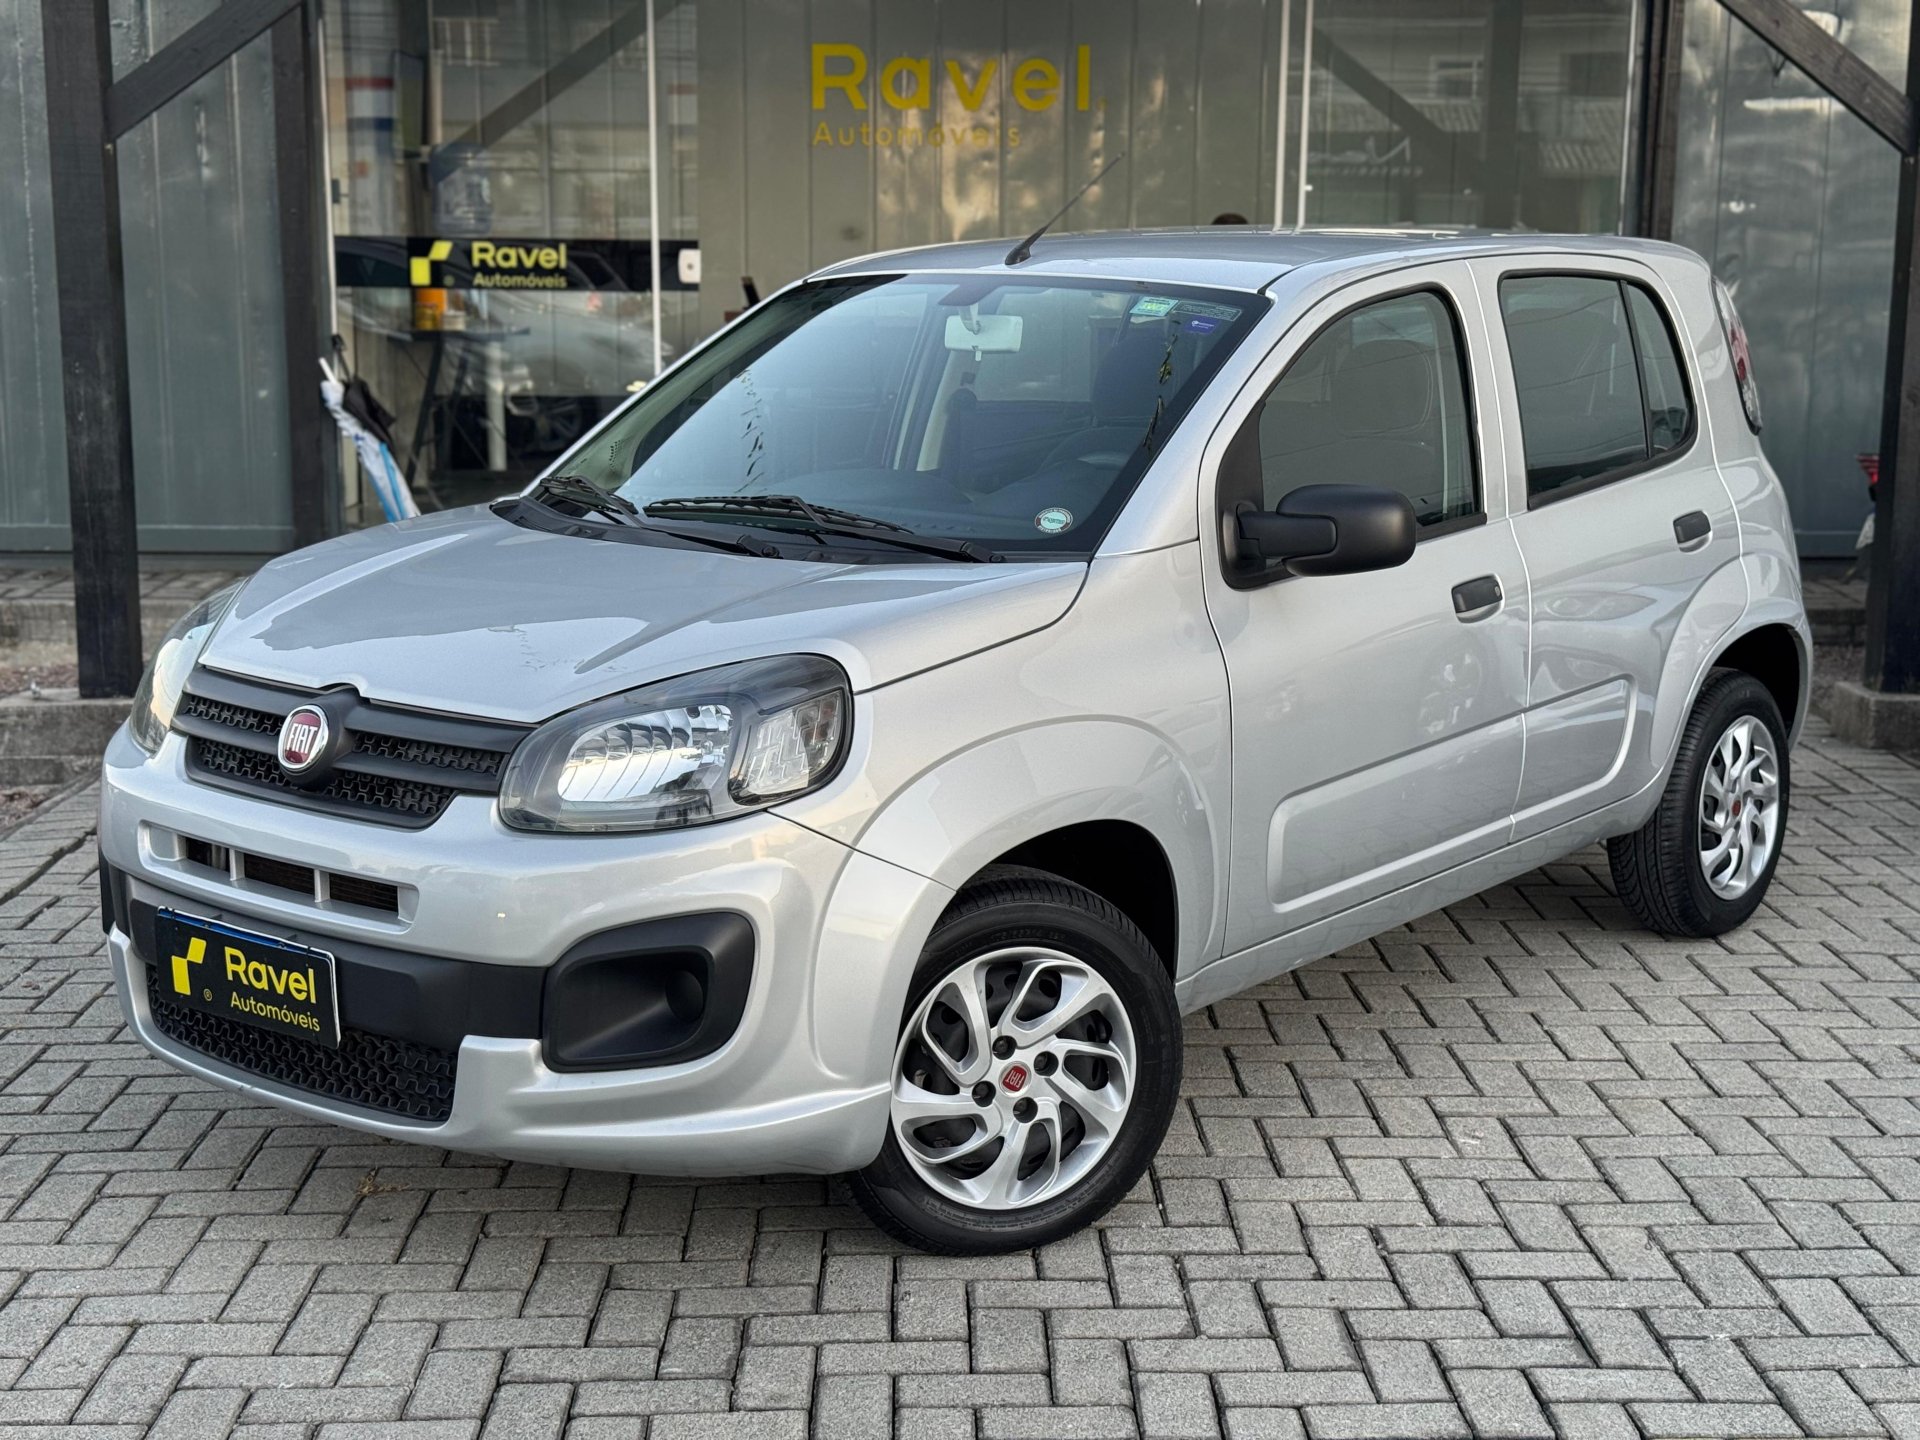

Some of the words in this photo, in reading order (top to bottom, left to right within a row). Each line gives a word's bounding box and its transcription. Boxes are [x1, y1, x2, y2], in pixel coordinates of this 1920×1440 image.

[811, 42, 1091, 112] Ravel
[471, 241, 567, 269] Ravel
[473, 273, 567, 288] Automóveis
[286, 723, 318, 754] FIAT
[224, 945, 317, 1005] Ravel
[230, 990, 321, 1033] Automóveis
[1004, 1069, 1026, 1089] FIAT
